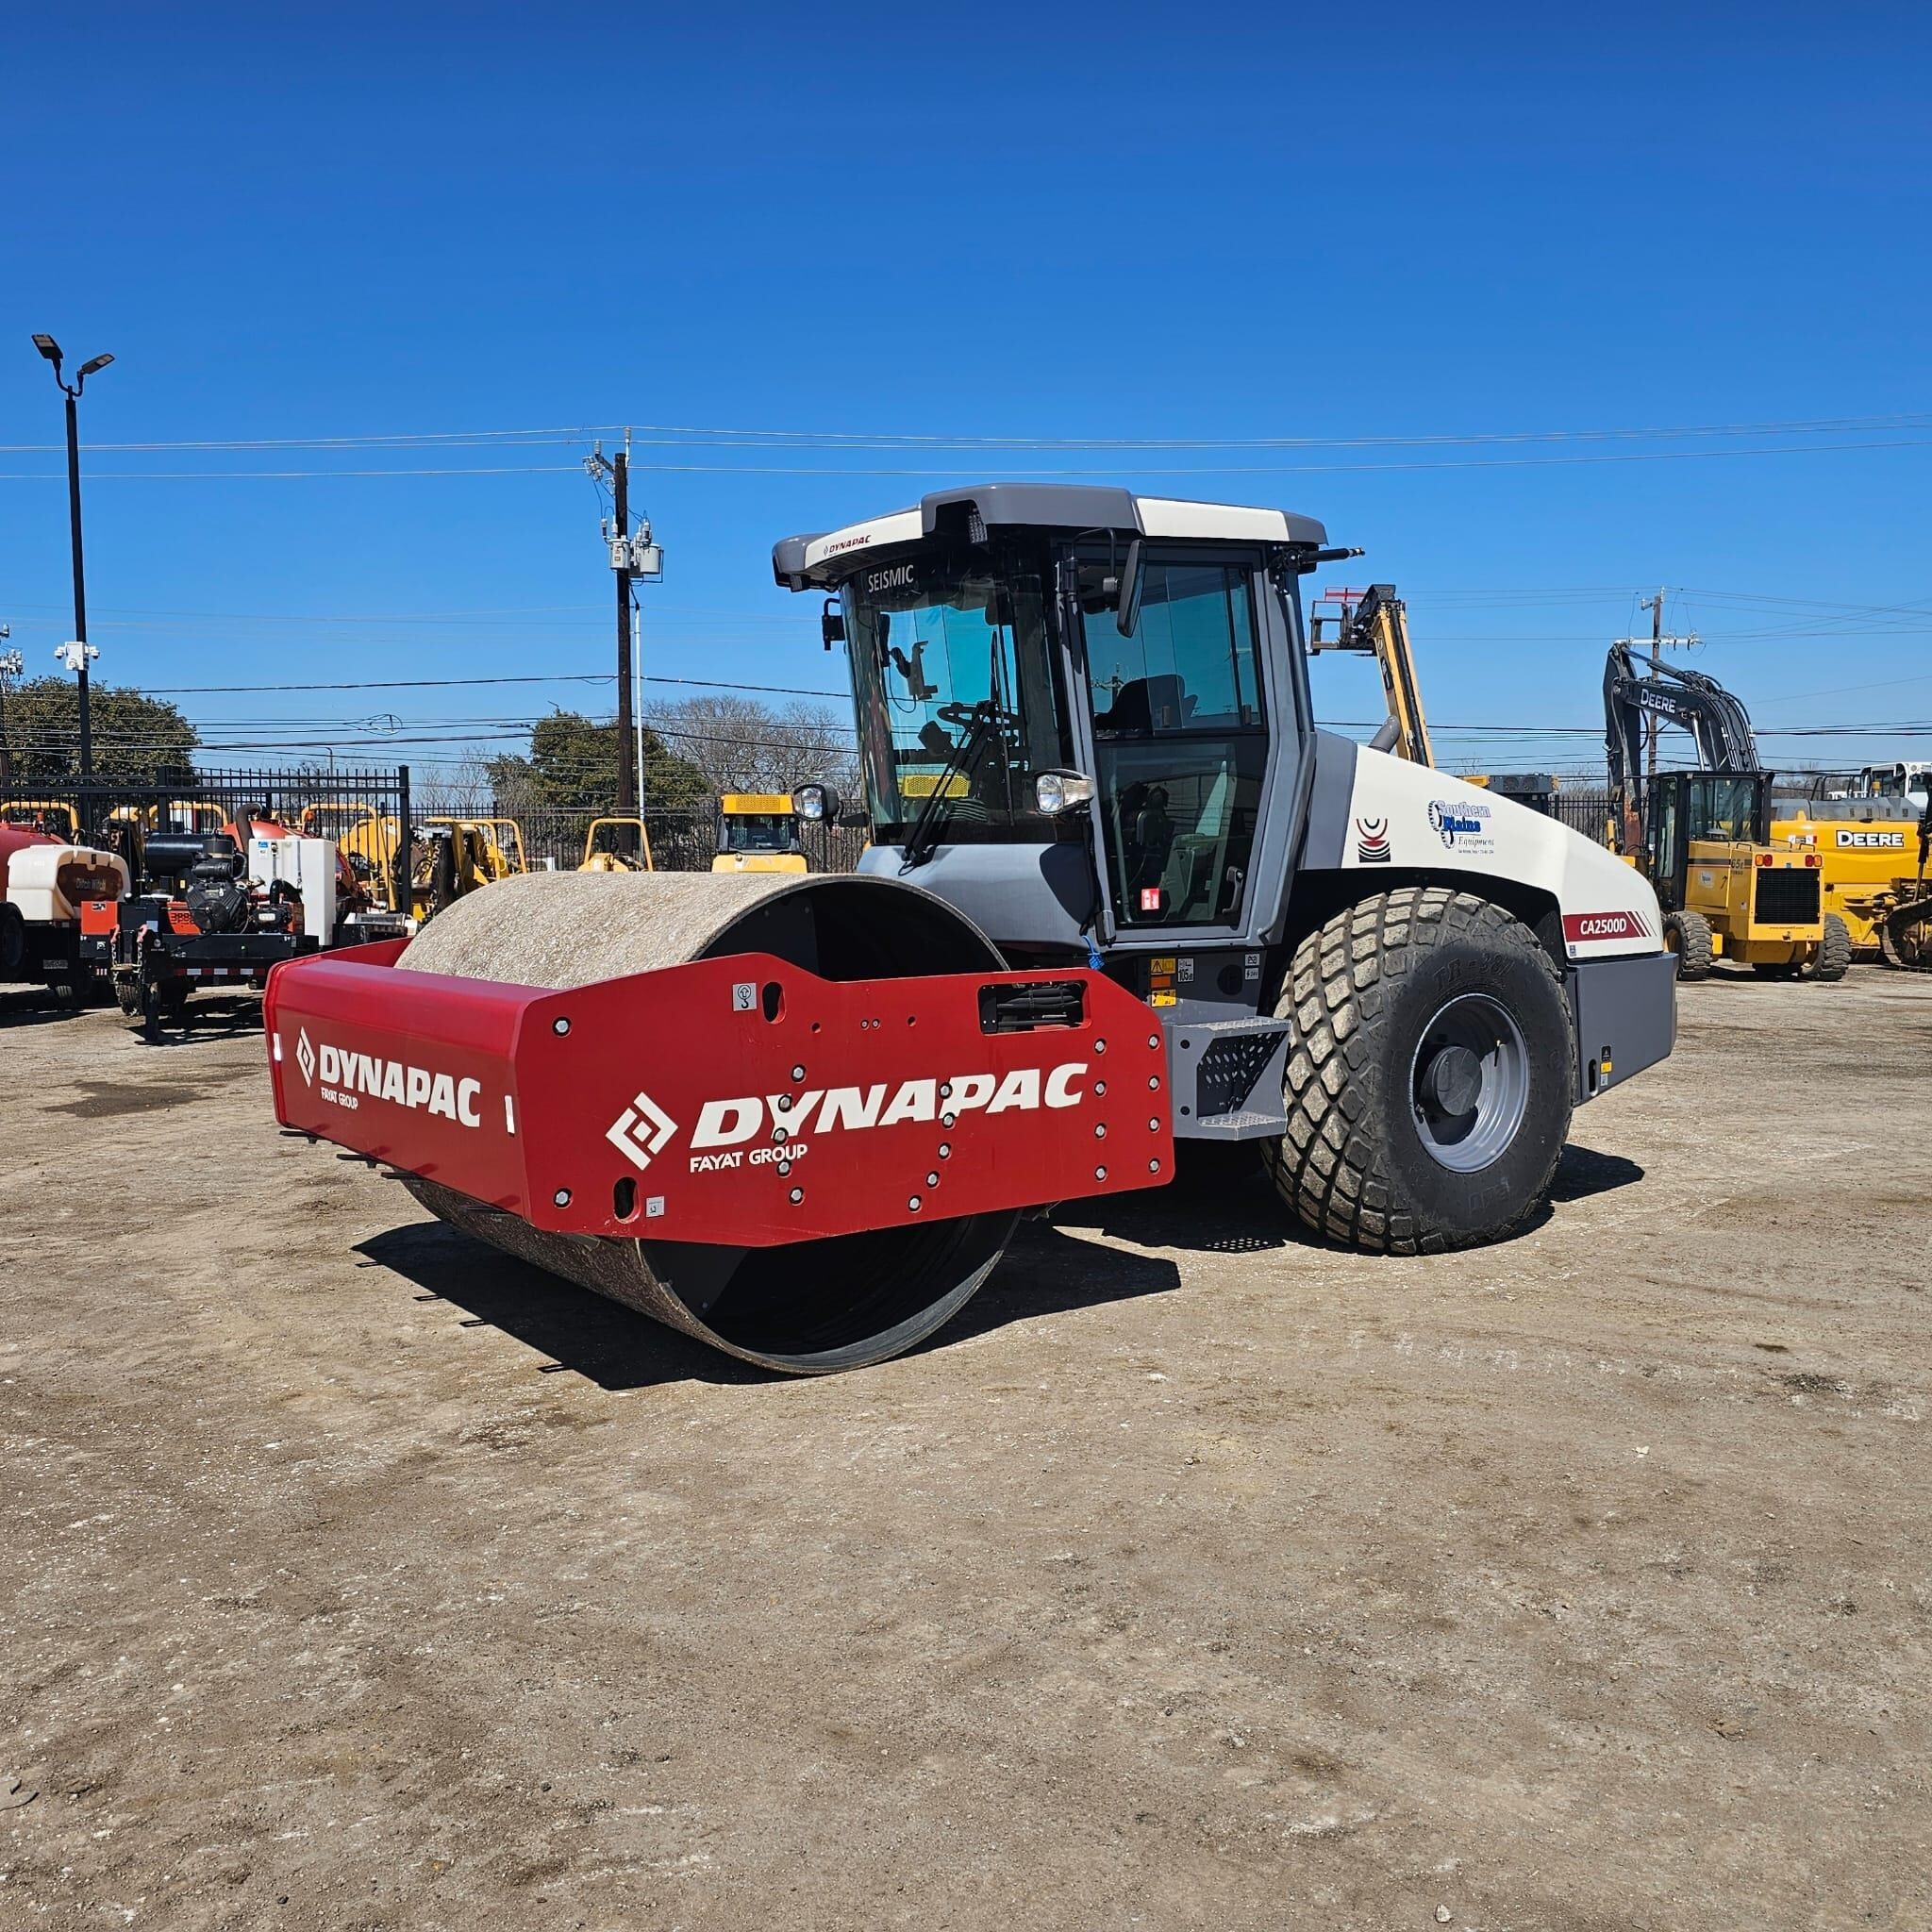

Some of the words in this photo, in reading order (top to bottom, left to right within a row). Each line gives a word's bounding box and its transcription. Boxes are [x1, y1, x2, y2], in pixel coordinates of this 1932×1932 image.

[829, 535, 872, 553] DYNAPAC
[868, 564, 914, 593] SEISMIC
[1641, 688, 1676, 714] DEERE
[1437, 800, 1491, 818] Southern
[1442, 815, 1481, 832] Plains
[1836, 829, 1905, 848] DEERE
[1580, 918, 1627, 935] CA2500D
[320, 1043, 481, 1127] DYNAPAC
[321, 1087, 338, 1104] FAYAT
[338, 1092, 358, 1110] GROUP
[690, 1062, 1089, 1149] DYNAPAC
[690, 1151, 743, 1174] FAYAT
[748, 1143, 808, 1165] GROUP
